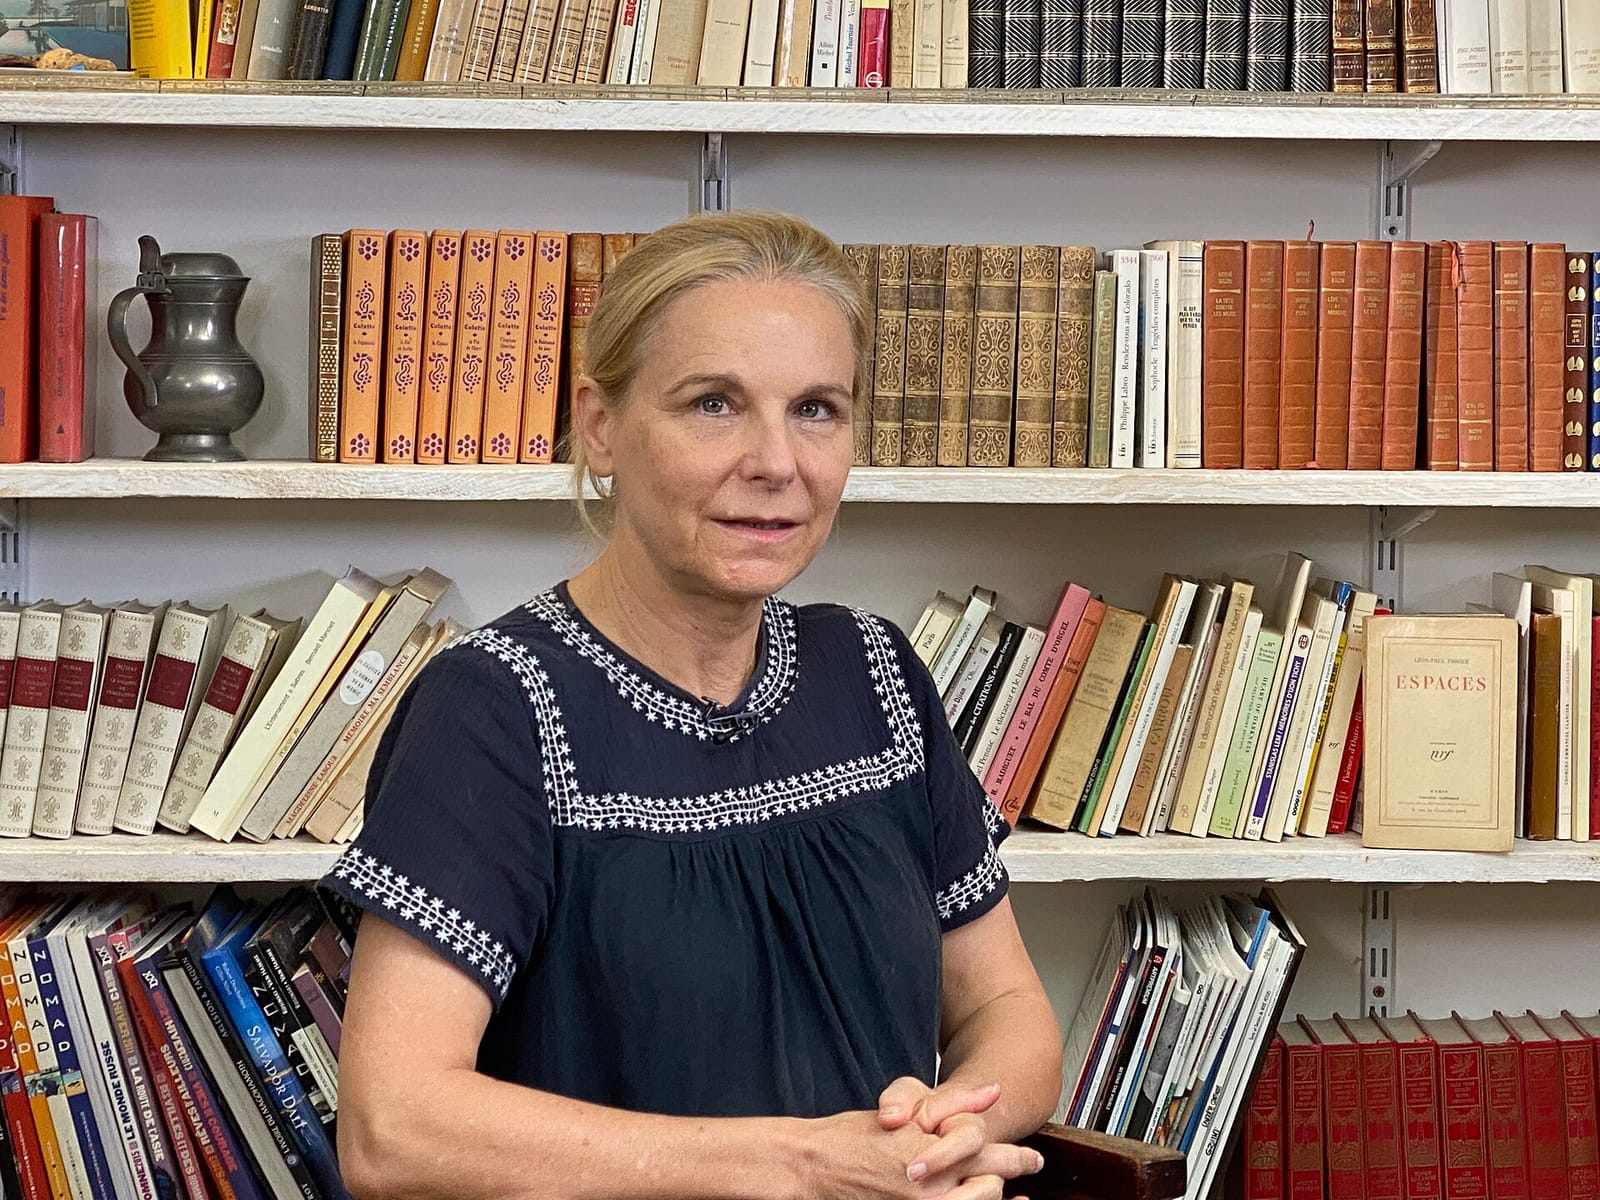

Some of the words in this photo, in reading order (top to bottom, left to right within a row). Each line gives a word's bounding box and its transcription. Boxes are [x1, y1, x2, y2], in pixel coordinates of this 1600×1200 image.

[845, 51, 853, 74] Michel
[1124, 279, 1132, 314] Colorado
[464, 323, 485, 331] Colette
[497, 322, 520, 330] Colette
[1102, 298, 1114, 355] CARCO
[1152, 316, 1161, 351] Tragédies
[1122, 326, 1130, 371] Rendez-vous
[1121, 376, 1129, 400] Labro
[1151, 357, 1160, 392] Sophocle
[1097, 366, 1110, 431] FRANCIS
[1120, 400, 1131, 431] Philippe
[922, 631, 935, 649] Paris
[1050, 619, 1070, 652] D'ORGEL
[291, 669, 305, 688] Sabres
[305, 642, 321, 664] Bernard
[1037, 656, 1054, 682] COMTE
[1199, 695, 1217, 738] destruction
[1212, 678, 1222, 694] des
[1217, 642, 1234, 678] remparts
[1228, 608, 1241, 635] hubert
[1291, 660, 1301, 678] TICHY
[954, 686, 966, 703] Djian
[971, 674, 997, 715] CITATIONS
[1031, 685, 1041, 698] DU
[1258, 677, 1267, 700] HEART
[1396, 674, 1487, 692] ESPACES
[316, 753, 337, 781] LABOUR
[343, 709, 369, 744] MÉMOIRE
[367, 695, 379, 709] MA
[377, 653, 407, 695] SEMBLANCE
[978, 739, 995, 765] Pennac
[994, 693, 1014, 725] dictateur
[1014, 653, 1031, 678] hamac
[1022, 700, 1035, 716] BAL
[1255, 703, 1261, 712] OF
[1276, 699, 1291, 730] MÉMOIRES
[1017, 718, 1028, 730] LE
[1245, 716, 1257, 752] DARKNESS
[1273, 734, 1282, 747] LEM
[994, 746, 1016, 783] RADIGUET
[1265, 748, 1278, 778] STANISLAS
[1342, 755, 1354, 782] Poèmes
[1430, 750, 1455, 763] nrf
[1232, 769, 1241, 785] Joseph
[1228, 787, 1237, 804] Conrad
[180, 954, 204, 990] TARQUIN
[214, 965, 225, 979] Gilles
[220, 962, 233, 979] Robert
[253, 954, 267, 975] HAMME
[265, 948, 280, 969] HAMME
[263, 974, 274, 986] VAN
[276, 968, 286, 981] VAN
[13, 950, 50, 1053] NOMAD
[33, 949, 70, 1052] NOMAD
[204, 998, 230, 1038] ARLESTON
[252, 984, 311, 1077] NOMAD
[165, 1020, 184, 1056] HIVER
[100, 1040, 119, 1079] RUSSE
[246, 1026, 289, 1093] SALVADOR
[131, 1066, 143, 1084] LA
[235, 1058, 270, 1115] MAGOHAMOTH
[111, 1081, 131, 1124] MONDE
[135, 1084, 151, 1109] ROUTE
[142, 1109, 155, 1126] DE
[185, 1105, 211, 1146] RÊVES
[263, 1112, 276, 1126] DU
[124, 1124, 136, 1140] LE
[147, 1127, 165, 1161] L'ASIE
[164, 1099, 184, 1139] VILLES
[180, 1150, 194, 1174] DES
